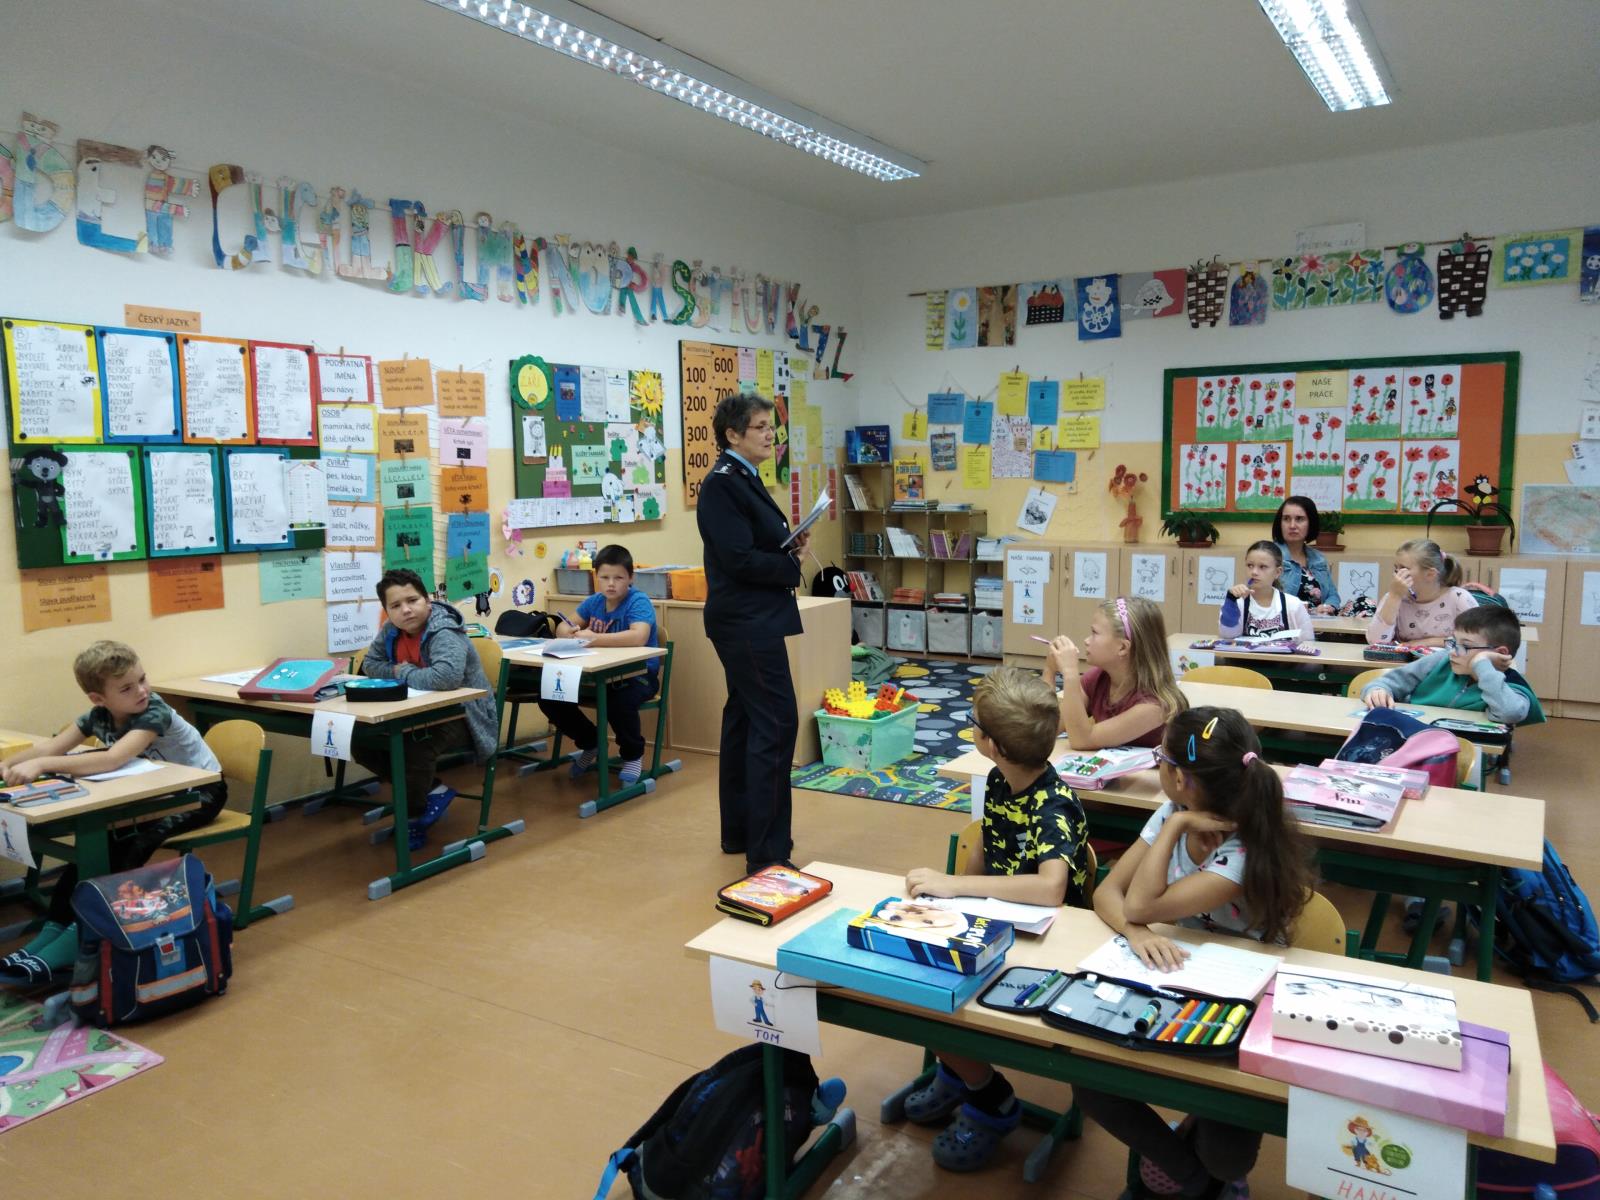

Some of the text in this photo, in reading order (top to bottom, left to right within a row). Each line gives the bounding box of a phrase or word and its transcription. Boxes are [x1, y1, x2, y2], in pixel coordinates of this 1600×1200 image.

[138, 312, 190, 327] ČESKÝ JAZYK
[714, 357, 734, 373] 600
[686, 367, 706, 384] 100
[1311, 376, 1332, 386] NAŠE
[714, 387, 734, 403] 700
[1309, 388, 1334, 399] PRÁCE
[686, 395, 707, 412] 200
[322, 422, 354, 431] maminka,
[687, 426, 708, 442] 300
[339, 434, 365, 443] učitelka
[688, 453, 709, 468] 400
[341, 472, 364, 482] klokan,
[331, 586, 363, 596] skromnost
[754, 1029, 781, 1045] TOM
